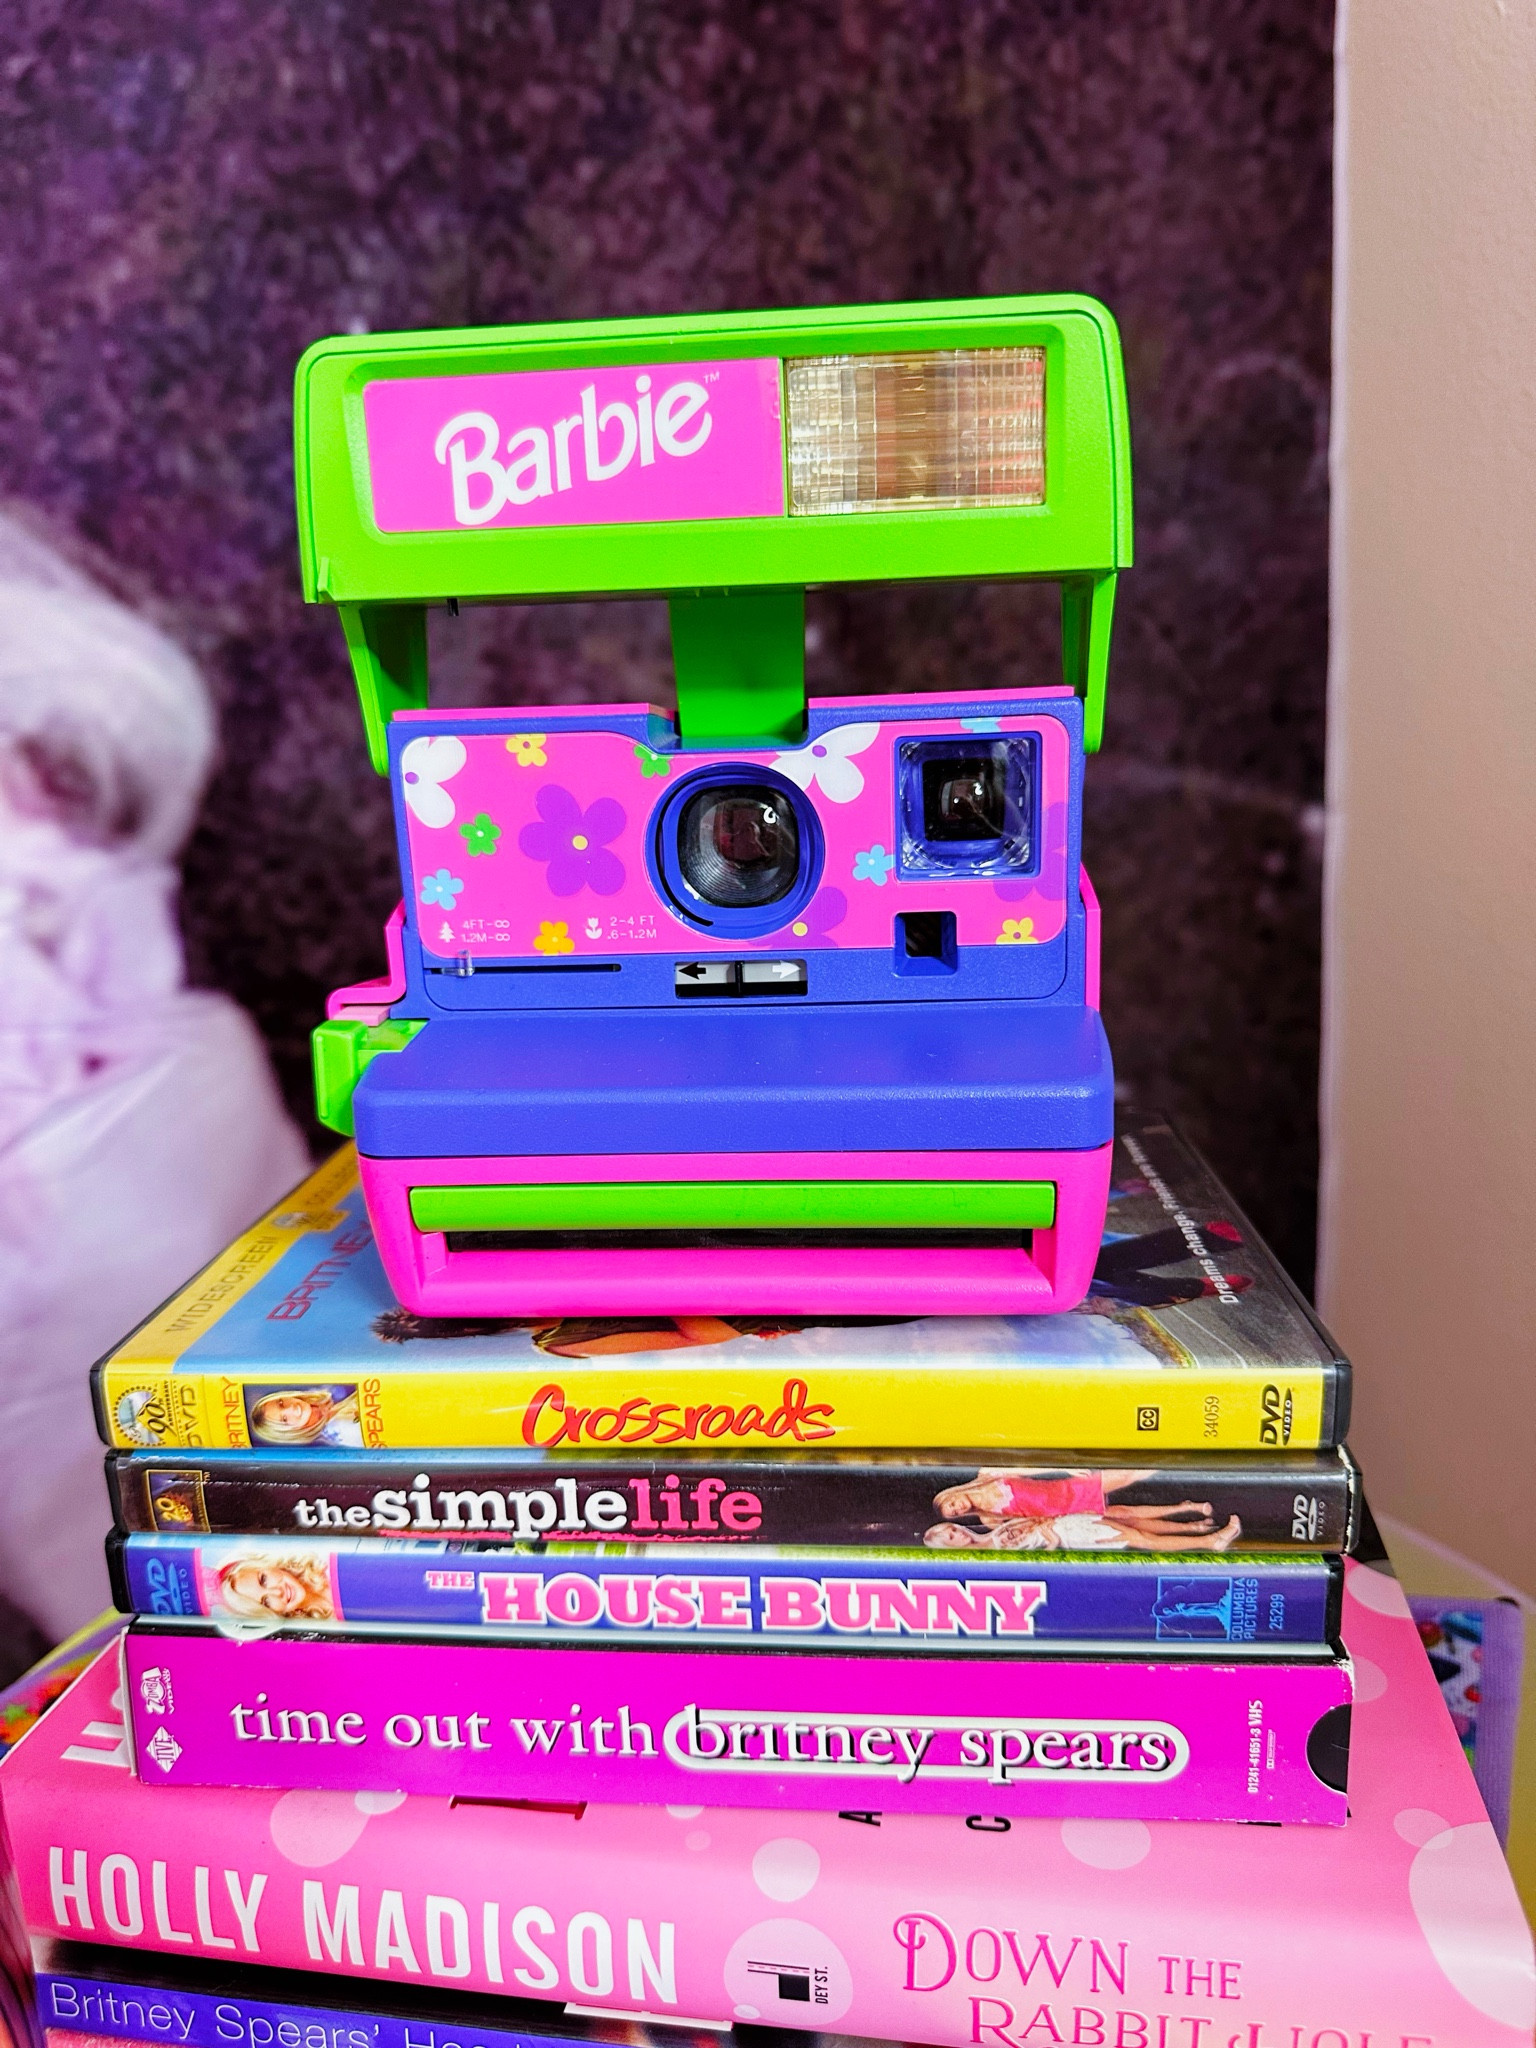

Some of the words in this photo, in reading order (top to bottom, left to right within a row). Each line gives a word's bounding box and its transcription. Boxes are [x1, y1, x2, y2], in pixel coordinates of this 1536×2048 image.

[434, 374, 713, 526] Barbie
[639, 914, 656, 926] FT
[165, 1235, 280, 1334] WIDESCREEN
[266, 1220, 374, 1321] BRITNE
[1199, 1258, 1239, 1304] Dreams
[521, 1378, 836, 1447] Crossroads
[1203, 1395, 1220, 1438] 34059
[1259, 1384, 1280, 1445] DVD
[1282, 1399, 1292, 1437] VIDEO
[1292, 1494, 1309, 1541] DVD
[1316, 1501, 1326, 1537] VIDEO
[425, 1569, 476, 1591] THE
[479, 1571, 753, 1631] HOUSE
[761, 1576, 1048, 1636] BUNNY
[1230, 1577, 1245, 1640] COLUMBIA
[1244, 1578, 1260, 1640] PICTURES
[1269, 1593, 1285, 1631] 25299
[229, 1692, 368, 1745] time
[383, 1709, 494, 1749] out
[509, 1703, 660, 1757] with
[683, 1702, 936, 1784] britney
[958, 1725, 1171, 1787] spears
[1247, 1699, 1264, 1727] VHS
[47, 1845, 270, 1954] HOLLY
[301, 1878, 680, 2006] MADISON
[814, 1966, 829, 1983] ST.
[892, 1909, 1131, 1996] DOWN
[1156, 1953, 1245, 2001] THE
[51, 1982, 196, 2040] Britney
[814, 1984, 829, 2005] DEY
[967, 1995, 1216, 2048] RABBIT
